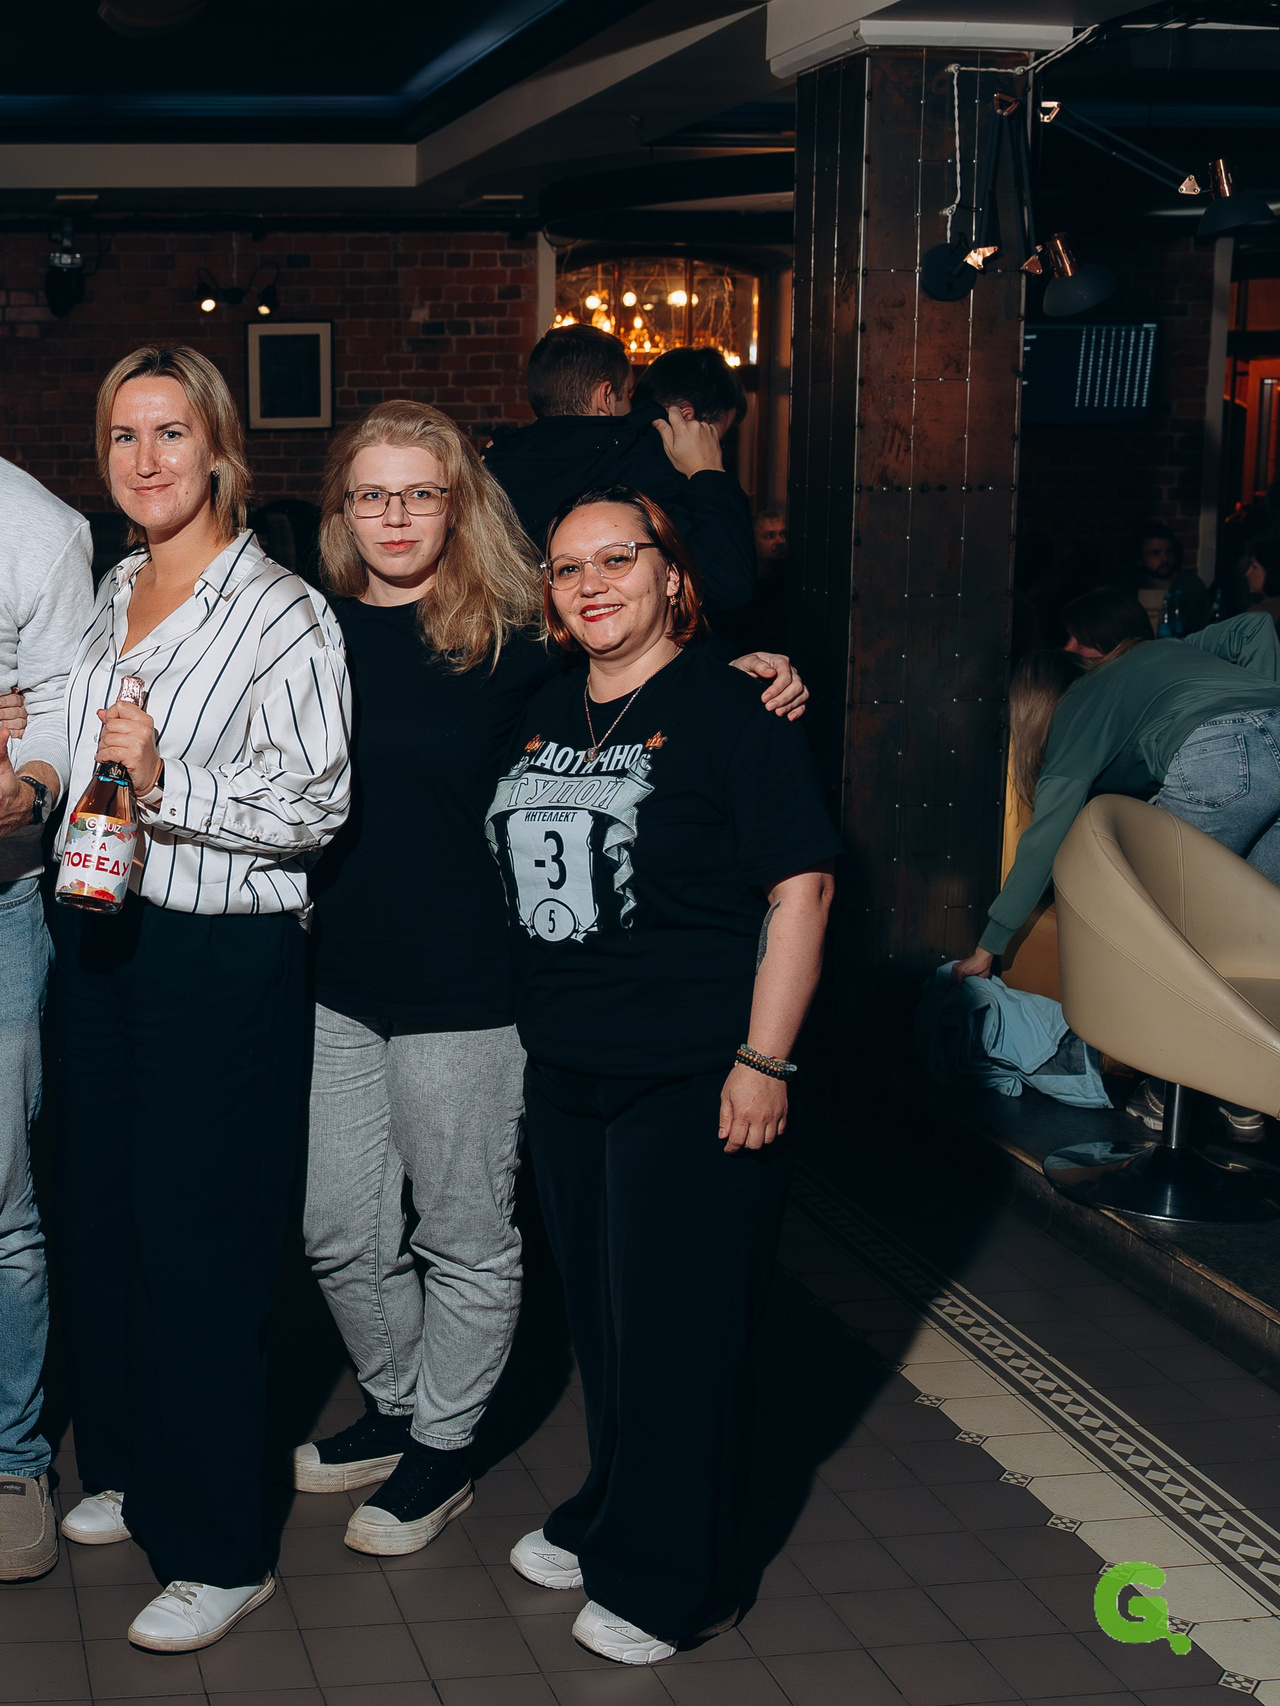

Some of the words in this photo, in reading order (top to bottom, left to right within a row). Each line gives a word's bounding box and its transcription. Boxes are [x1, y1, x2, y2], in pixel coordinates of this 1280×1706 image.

[507, 777, 625, 809] ТУПОЙ
[524, 811, 578, 823] ИНТЕЛЛЕКТ
[534, 830, 567, 890] -3
[548, 909, 556, 933] 5
